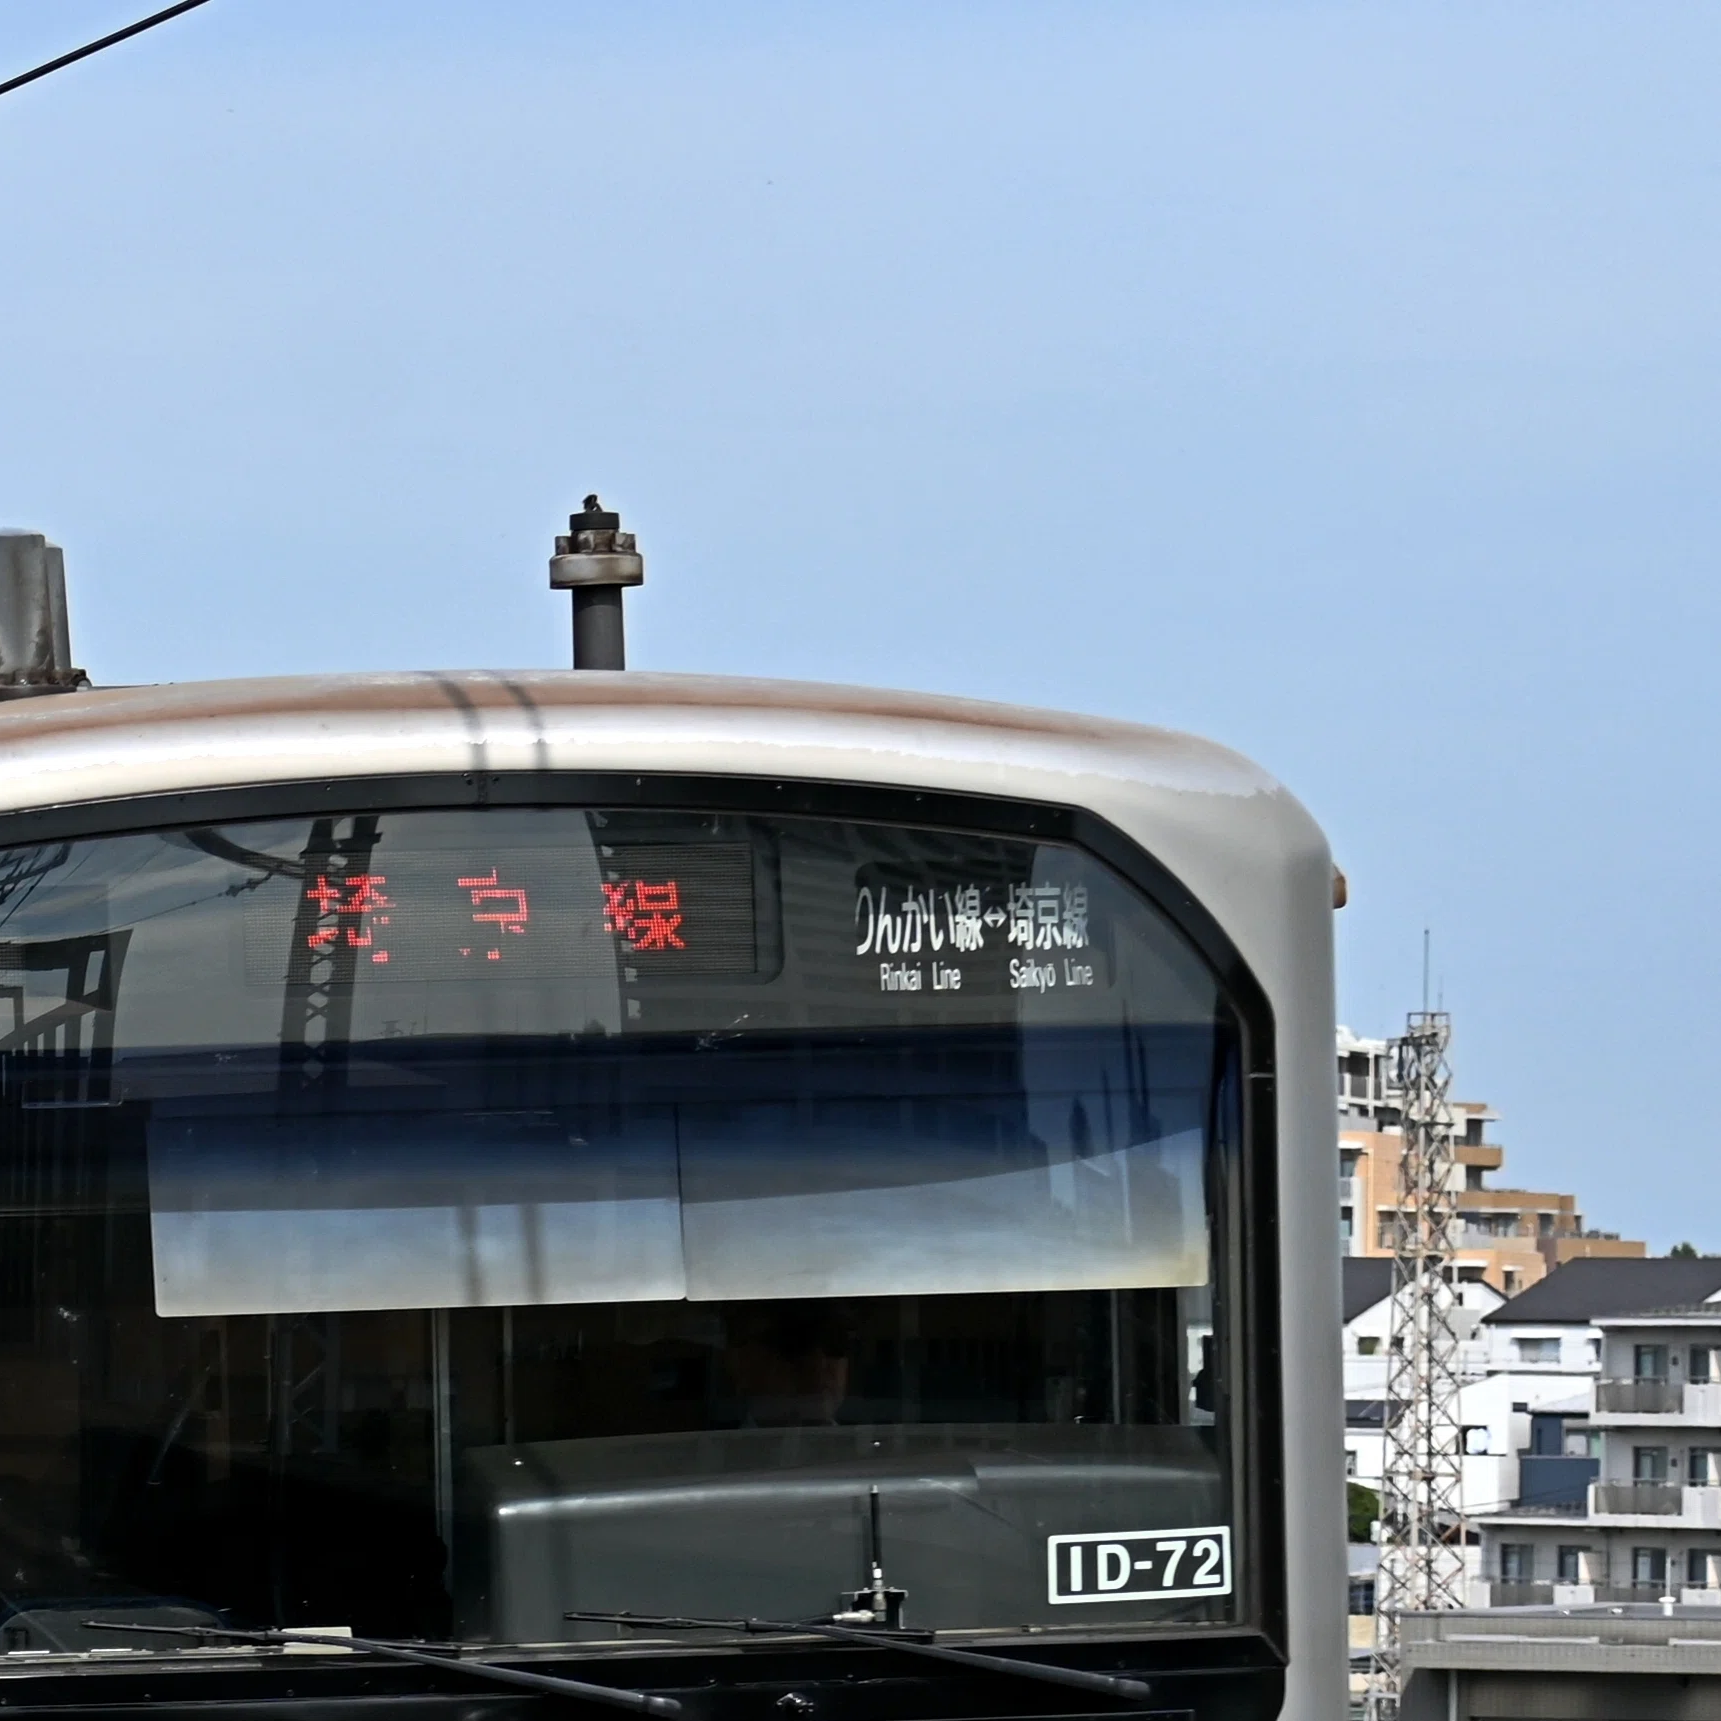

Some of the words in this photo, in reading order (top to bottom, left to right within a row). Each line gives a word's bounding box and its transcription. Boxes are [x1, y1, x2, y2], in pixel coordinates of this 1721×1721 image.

[880, 961, 922, 992] Rinkai
[932, 960, 962, 991] Line
[1064, 957, 1094, 988] Line
